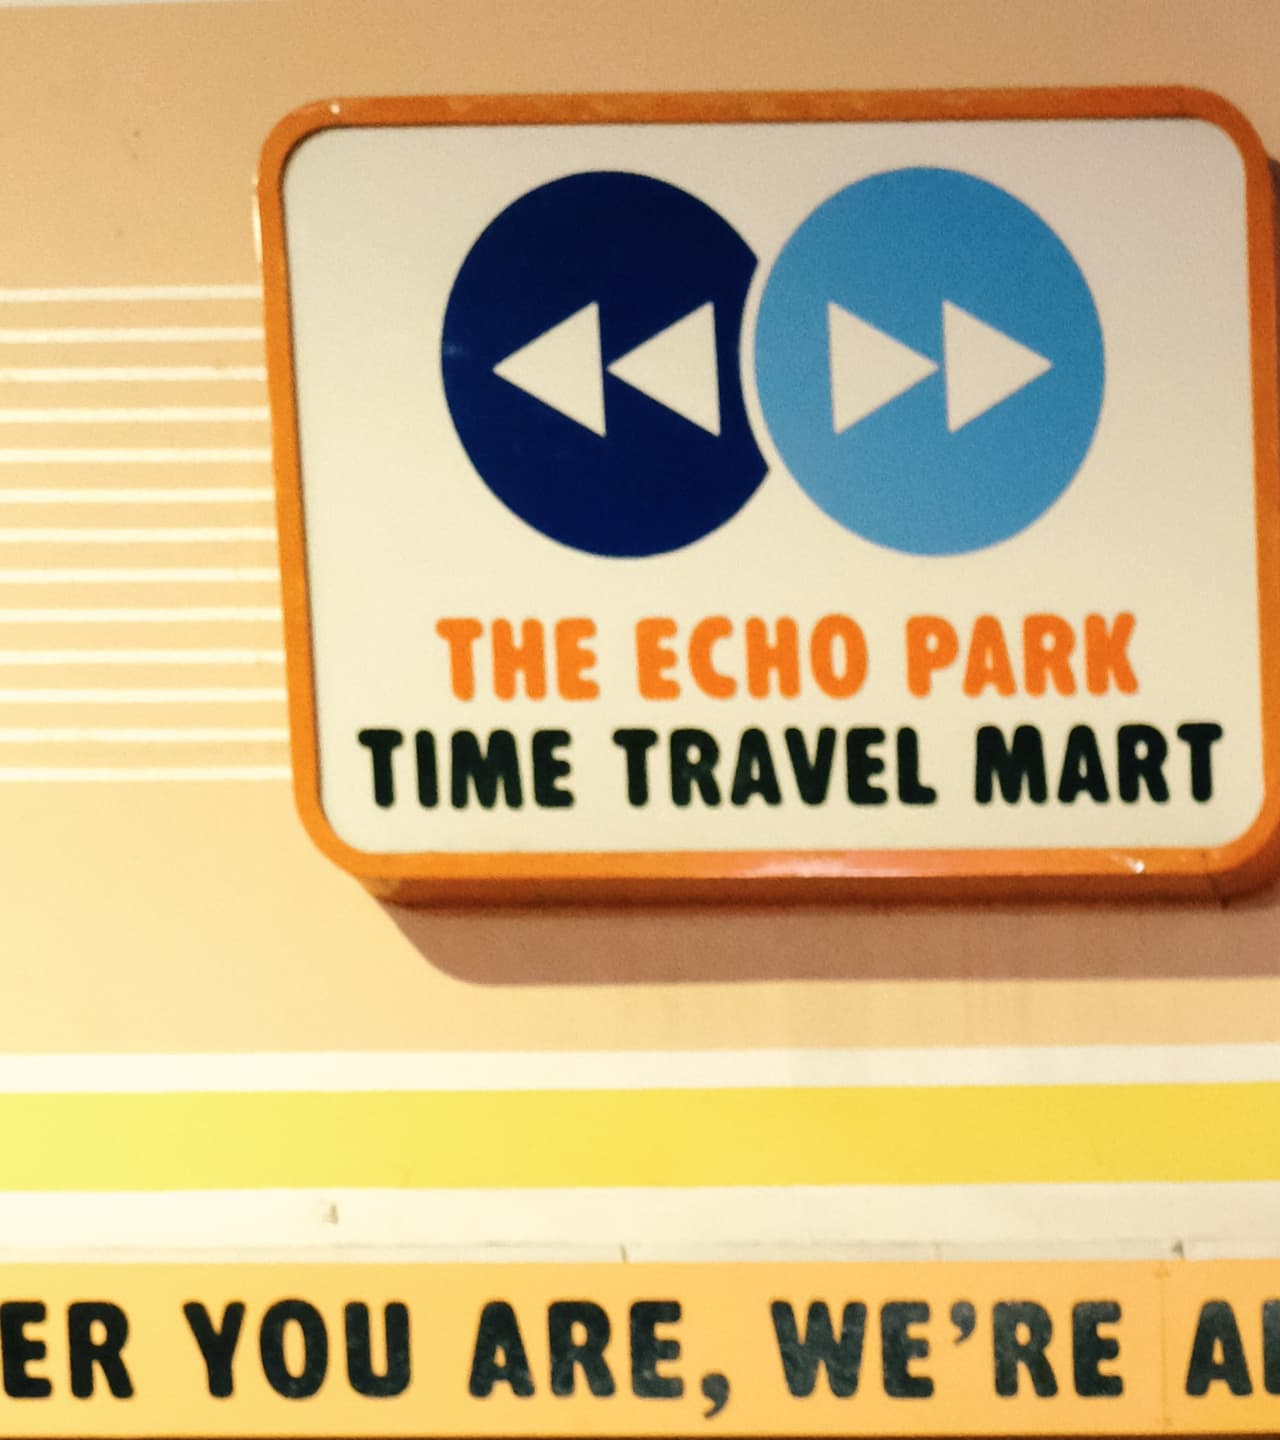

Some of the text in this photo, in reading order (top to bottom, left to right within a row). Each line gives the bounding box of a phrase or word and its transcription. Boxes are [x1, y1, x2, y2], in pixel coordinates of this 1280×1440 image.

[435, 611, 1139, 701] THE ECHO PARK
[357, 721, 1223, 809] TIME TRAVEL MART
[0, 1299, 137, 1400] ER
[183, 1298, 414, 1400] YOU
[466, 1298, 731, 1421] ARE,
[769, 1298, 1124, 1400] WE'RE
